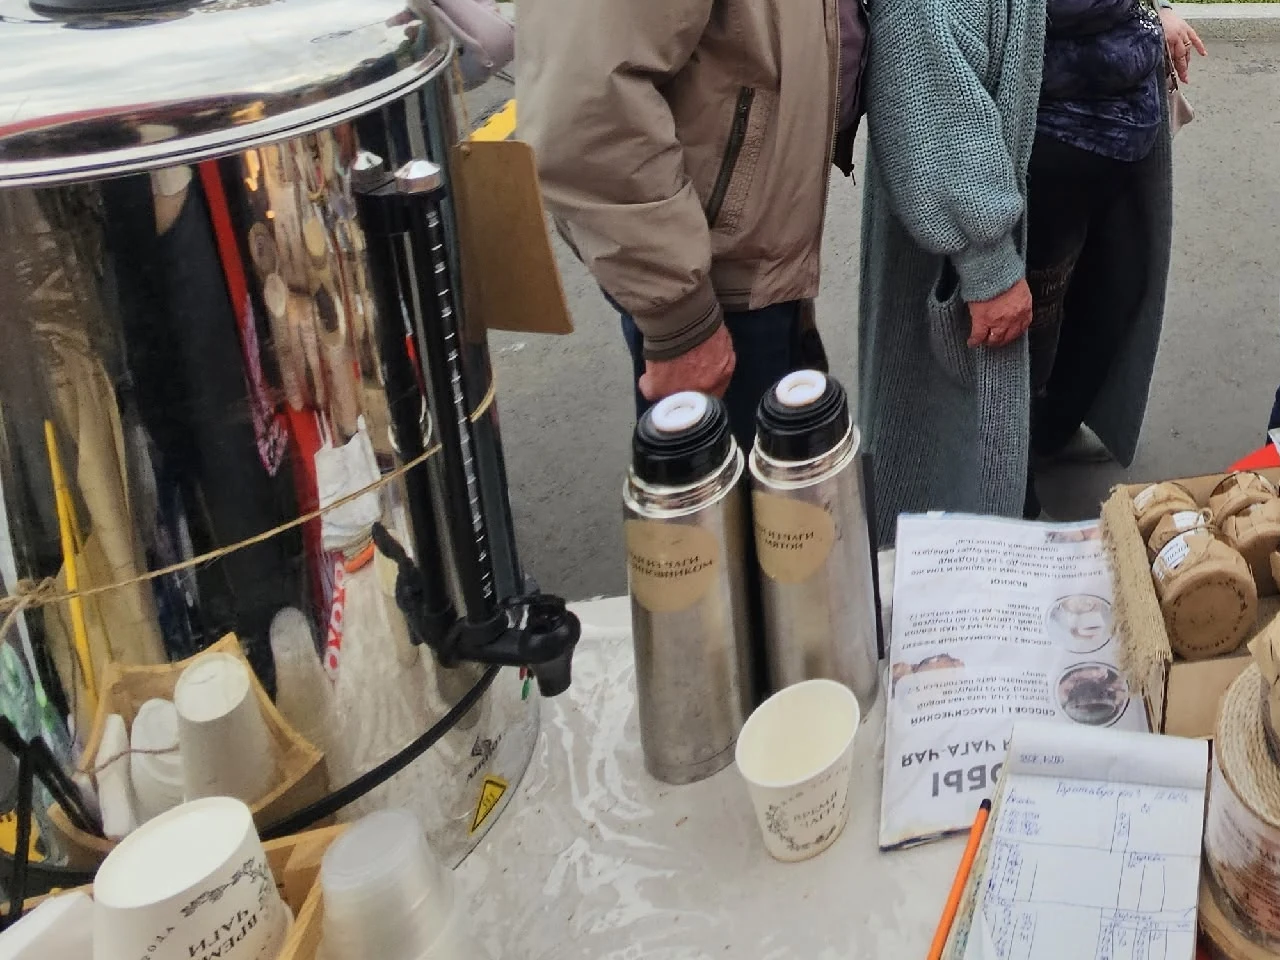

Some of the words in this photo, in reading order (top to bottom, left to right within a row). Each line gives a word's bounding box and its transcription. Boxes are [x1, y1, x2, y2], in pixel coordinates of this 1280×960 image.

[910, 707, 997, 725] КЛАССИЧЕСКИЙ
[1015, 706, 1056, 717] СПОСОБ
[901, 739, 997, 768] ЧАГА-ЧАЯ
[188, 908, 250, 958] ЧАГИ
